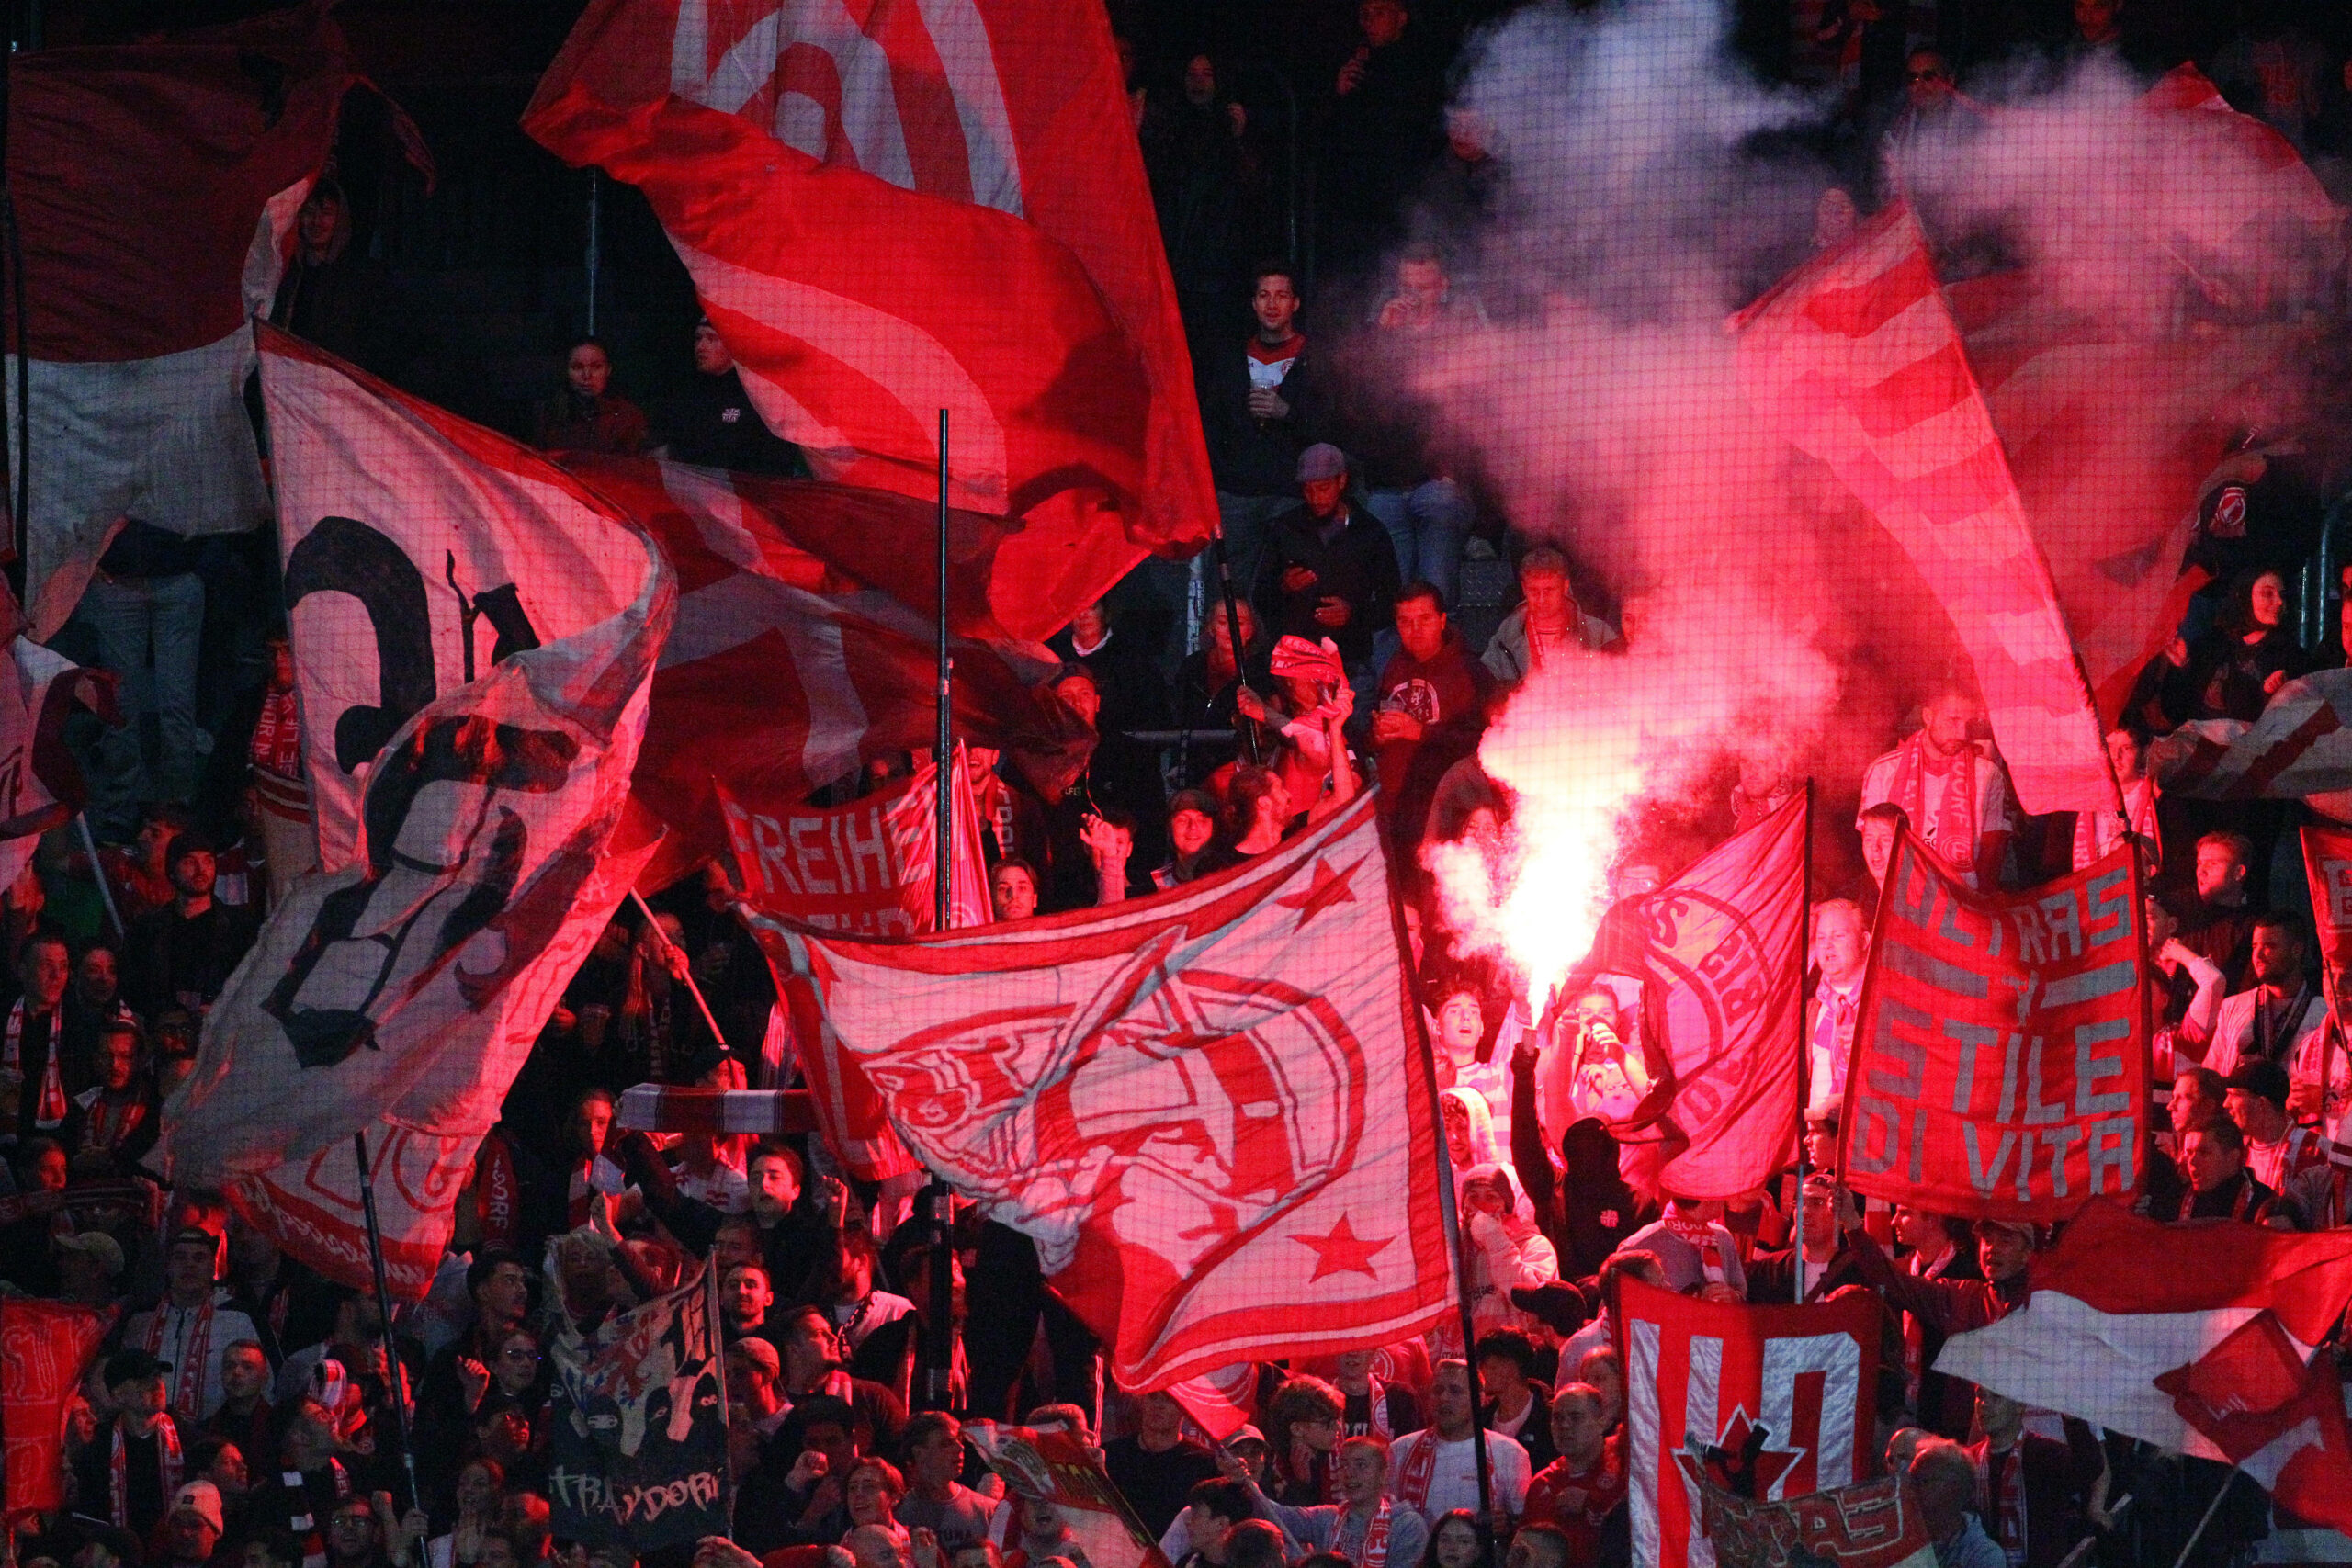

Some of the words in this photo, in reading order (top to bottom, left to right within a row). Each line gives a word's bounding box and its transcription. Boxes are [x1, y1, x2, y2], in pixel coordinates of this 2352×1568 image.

[1868, 997, 2131, 1125] STILE
[1850, 1096, 1928, 1184] DI
[1962, 1117, 2135, 1202] VITA
